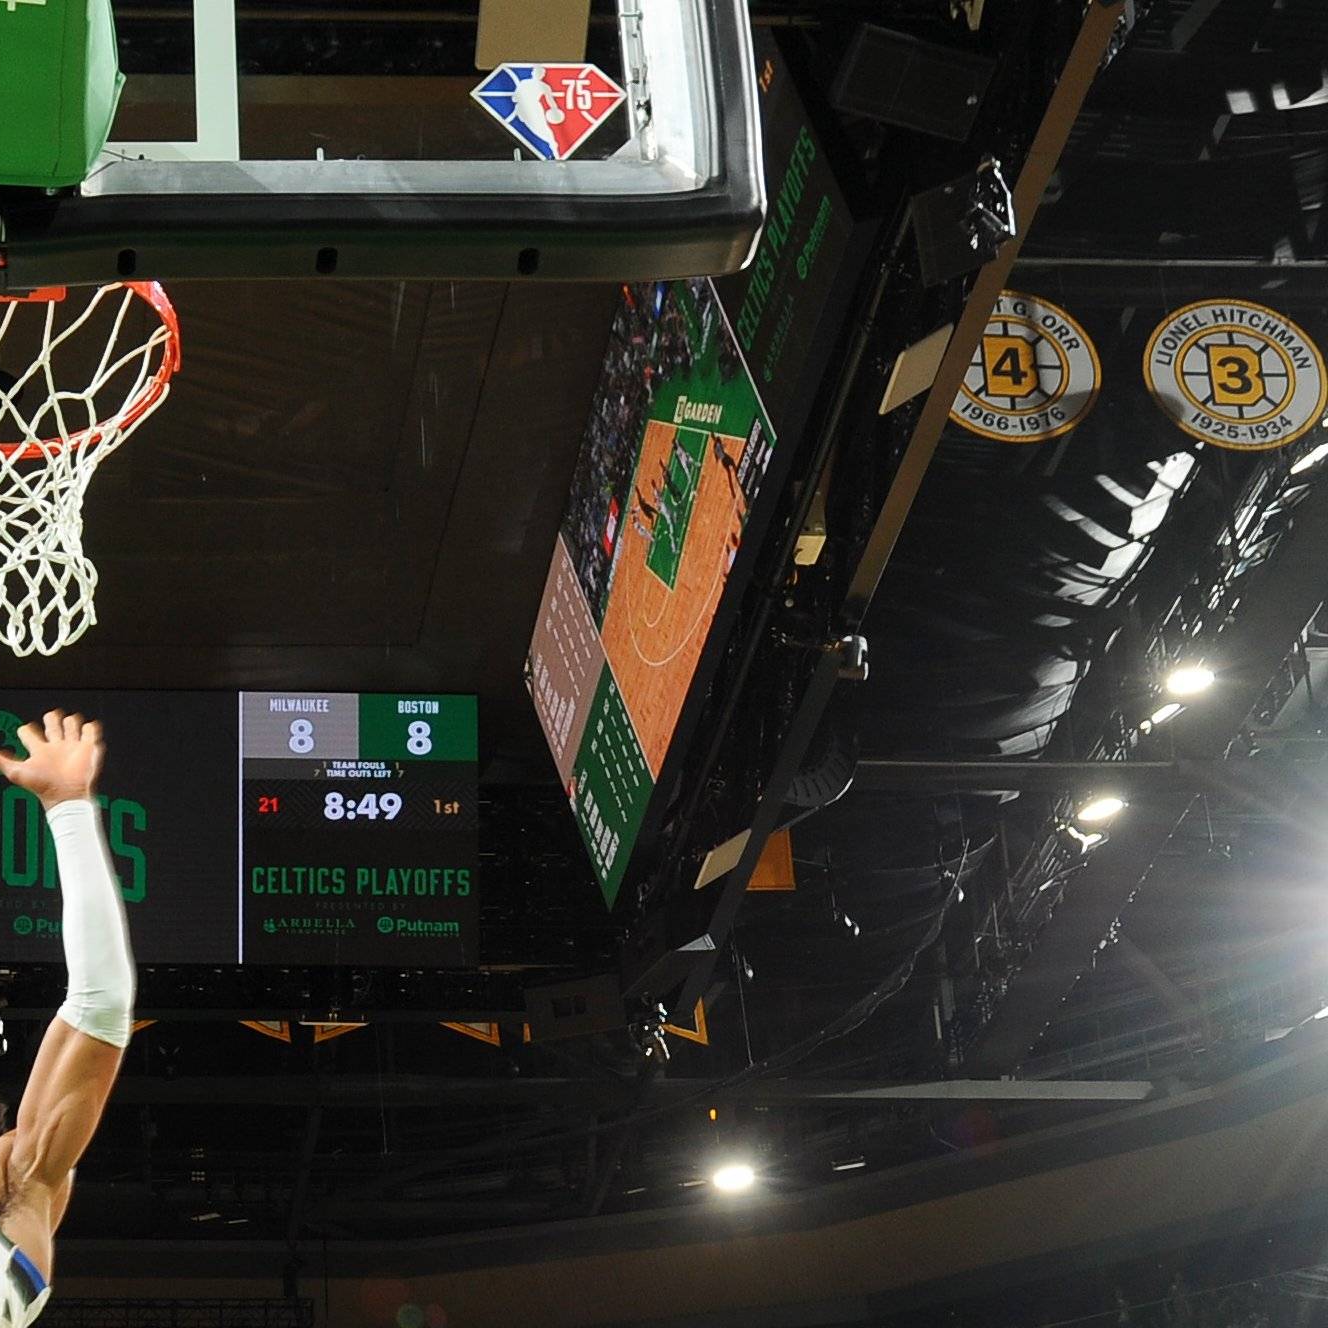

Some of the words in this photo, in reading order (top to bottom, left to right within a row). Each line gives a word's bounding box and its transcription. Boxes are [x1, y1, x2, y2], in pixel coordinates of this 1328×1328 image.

[563, 79, 592, 110] 75
[1042, 315, 1081, 352] ORR
[1155, 315, 1208, 366] LIONEL
[1212, 308, 1312, 371] HITCHMAN
[992, 347, 1028, 385] 4
[1217, 356, 1253, 395] 3
[684, 401, 722, 424] GARDEN
[960, 403, 1066, 431] 1966-1976
[1190, 411, 1293, 440] 1925-1934
[270, 698, 329, 713] MILWAUKEE
[398, 701, 439, 714] BOSTON
[289, 719, 314, 754] 8
[406, 721, 433, 755] 8
[332, 761, 356, 769] TEAM
[358, 761, 385, 769] FOULS
[348, 770, 372, 778] OUTS
[374, 770, 391, 778] LEFT
[258, 797, 279, 812] 21
[324, 791, 402, 820] 8:49
[252, 867, 346, 894] CELTICS
[356, 868, 470, 896] PLAYOFFS
[278, 918, 355, 928] ARBELLA
[397, 919, 459, 932] Putnam
